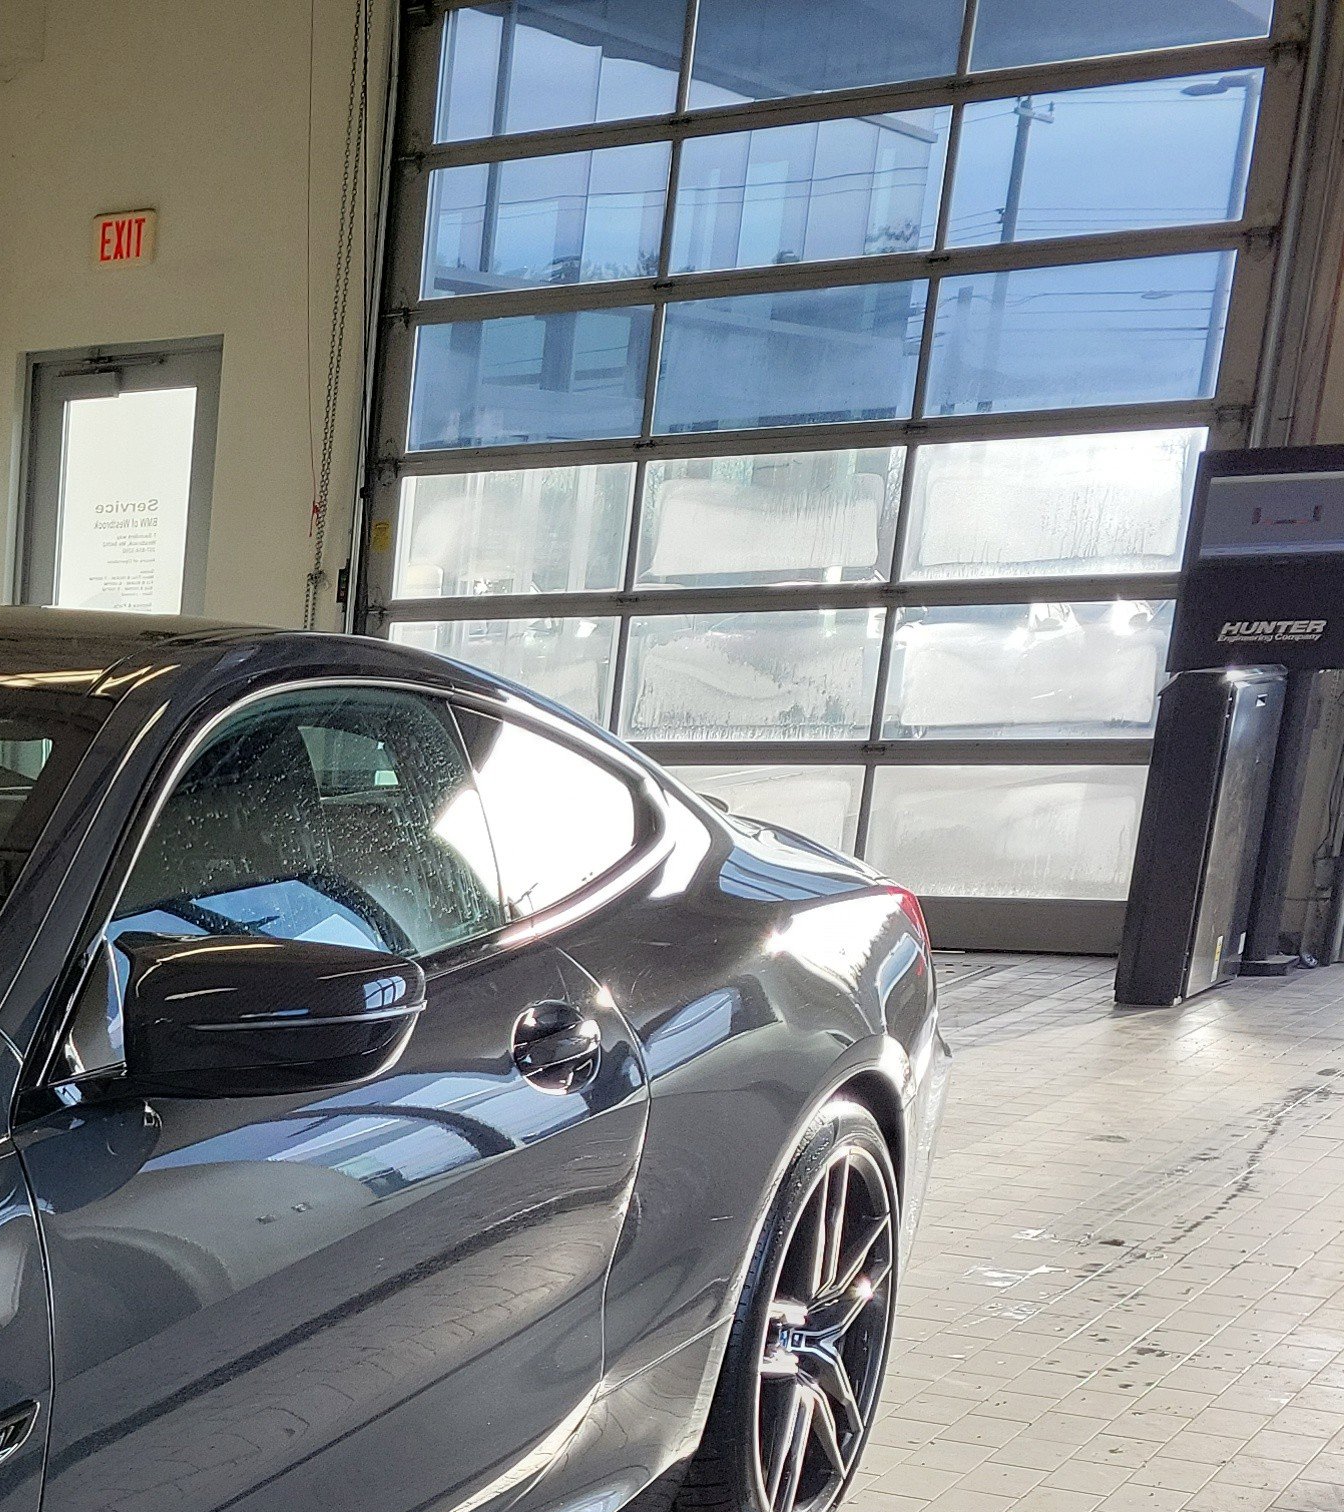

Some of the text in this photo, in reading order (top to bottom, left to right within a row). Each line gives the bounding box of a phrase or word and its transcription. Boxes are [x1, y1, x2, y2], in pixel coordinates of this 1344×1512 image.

[99, 218, 146, 262] EXIT
[1220, 619, 1328, 635] HUNTER
[1216, 632, 1323, 643] Engineering Company
